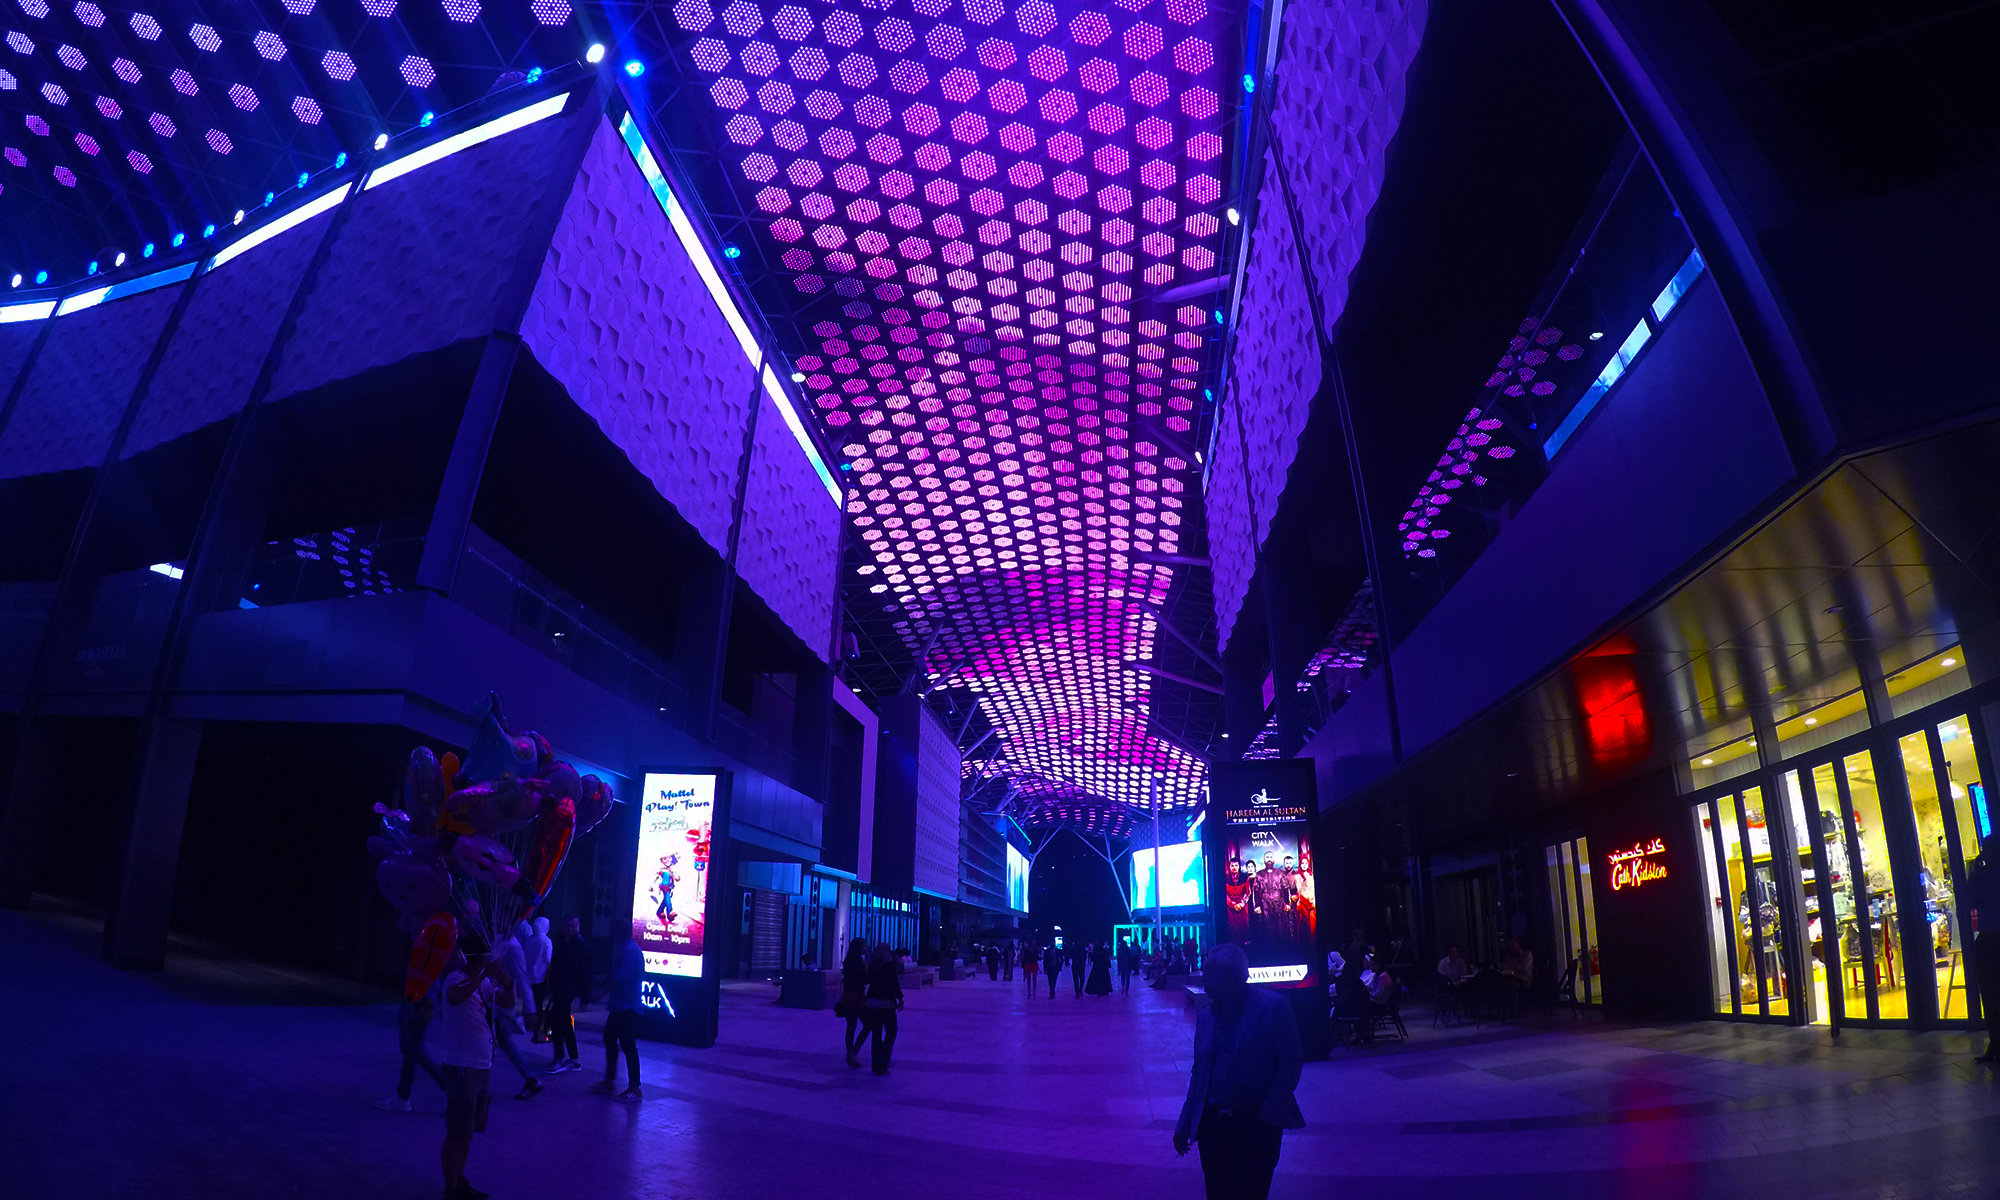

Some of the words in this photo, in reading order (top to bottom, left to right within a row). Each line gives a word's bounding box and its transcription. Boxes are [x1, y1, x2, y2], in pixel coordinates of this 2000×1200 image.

[660, 787, 695, 800] Mattel
[680, 799, 710, 810] Town
[1226, 809, 1261, 820] HAREEM
[1262, 808, 1273, 816] AL
[1274, 806, 1306, 816] SULTAN
[1251, 831, 1269, 839] CITY
[1251, 839, 1274, 847] WALK
[1612, 863, 1632, 891] Cath
[1631, 859, 1667, 887] Kidston
[646, 922, 666, 932] Open
[643, 931, 663, 941] 10am
[670, 934, 691, 945] 10pm
[1273, 969, 1302, 978] OPEN
